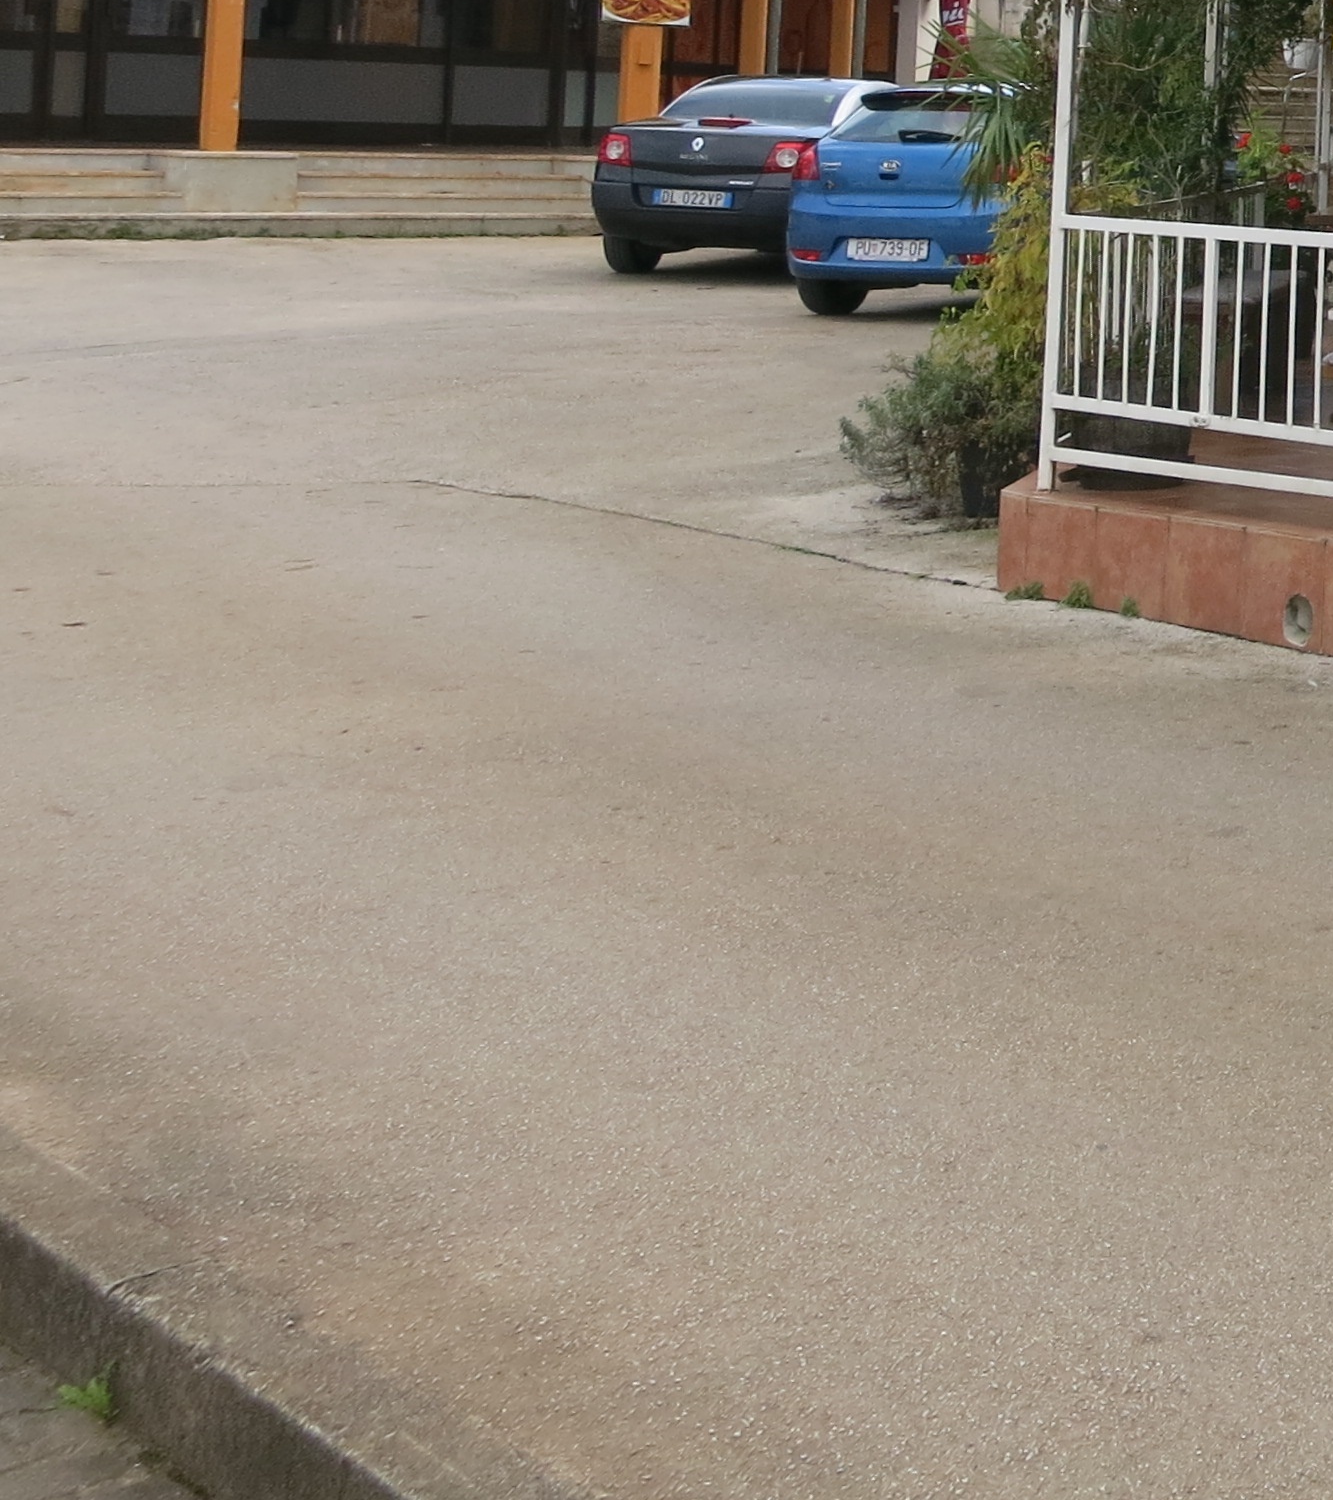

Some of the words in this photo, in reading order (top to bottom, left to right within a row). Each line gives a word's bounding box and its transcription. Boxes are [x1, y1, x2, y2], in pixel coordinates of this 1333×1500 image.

[662, 190, 677, 204] DL
[682, 191, 724, 206] 022VP
[855, 240, 871, 256] PU
